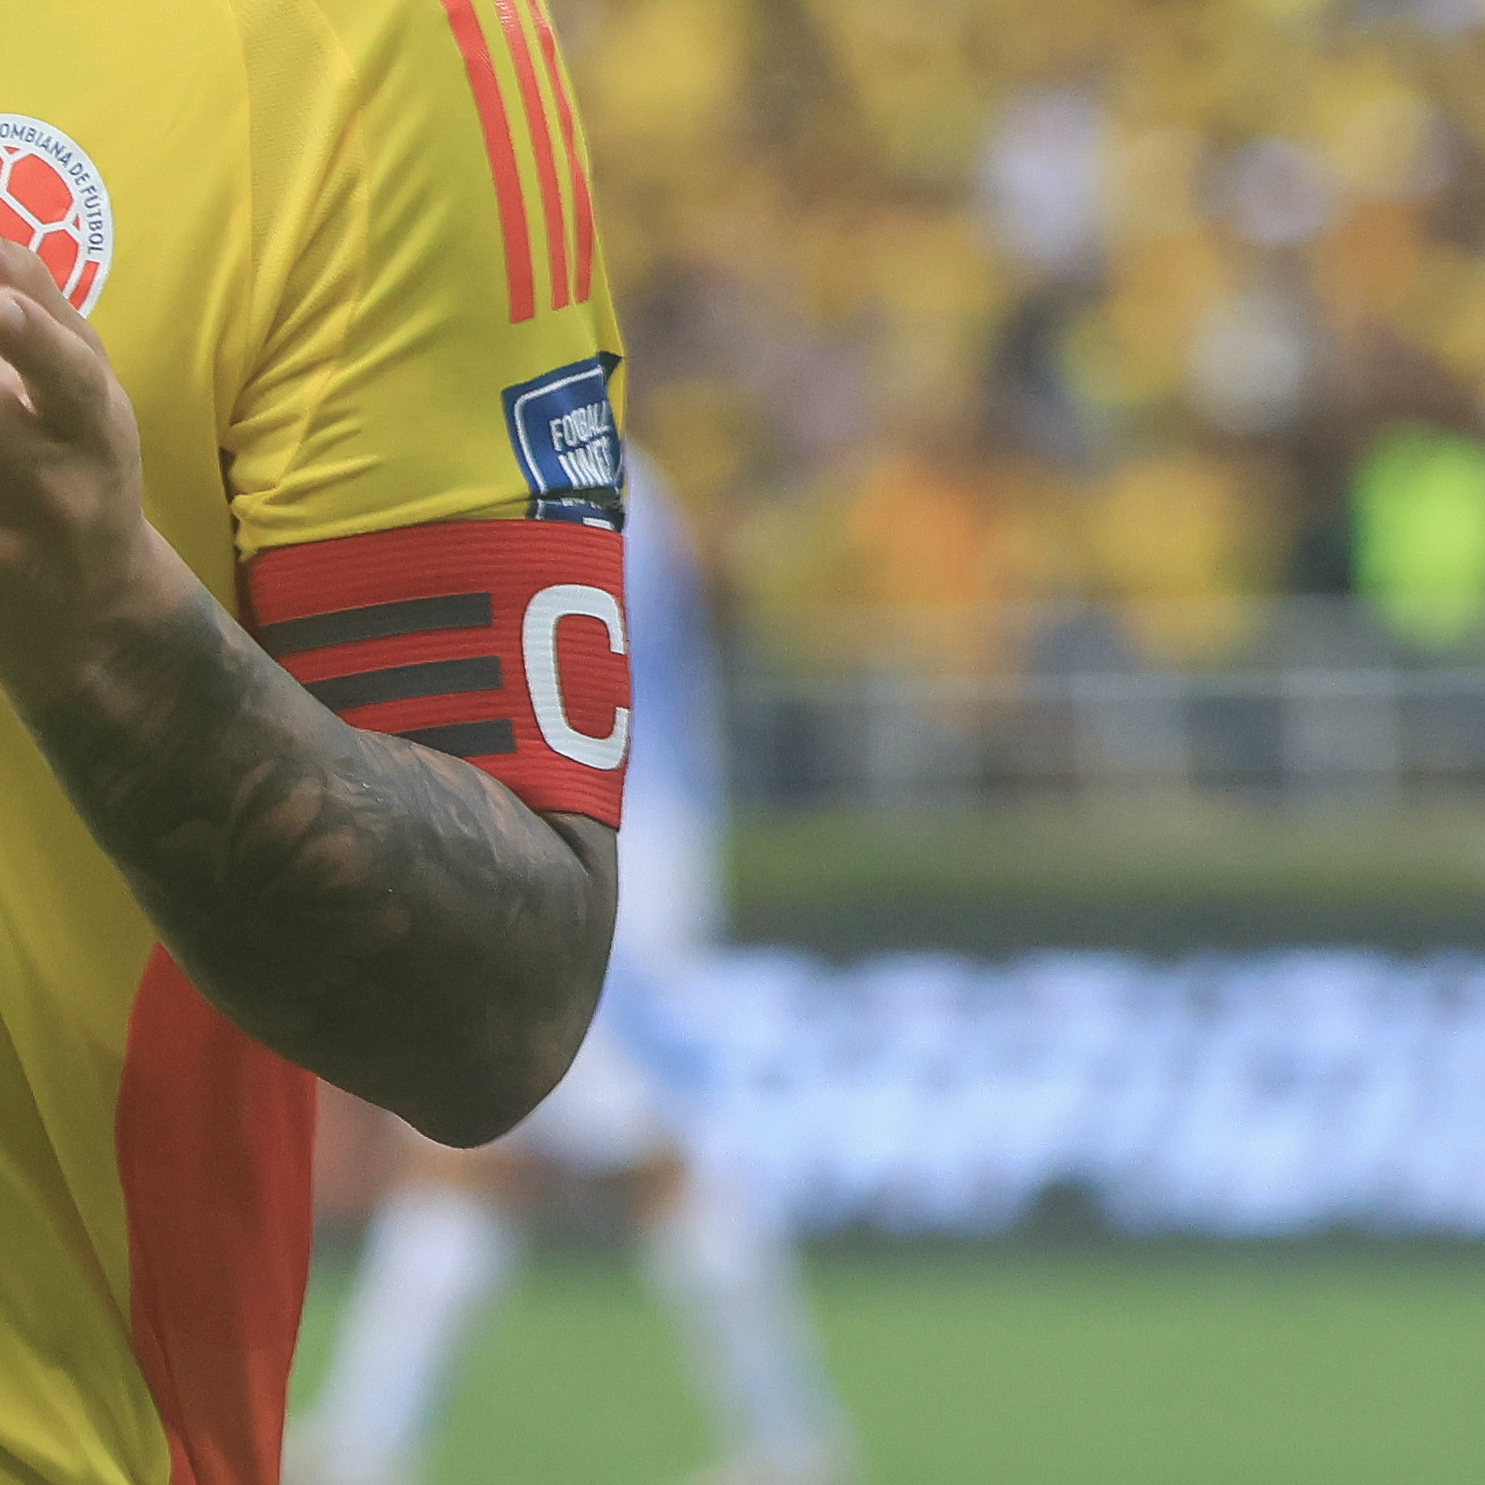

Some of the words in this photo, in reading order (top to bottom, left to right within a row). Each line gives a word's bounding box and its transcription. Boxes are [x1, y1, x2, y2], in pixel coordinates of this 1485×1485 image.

[68, 161, 90, 187] DE
[79, 184, 105, 255] FÚTBOL
[521, 583, 629, 771] C
